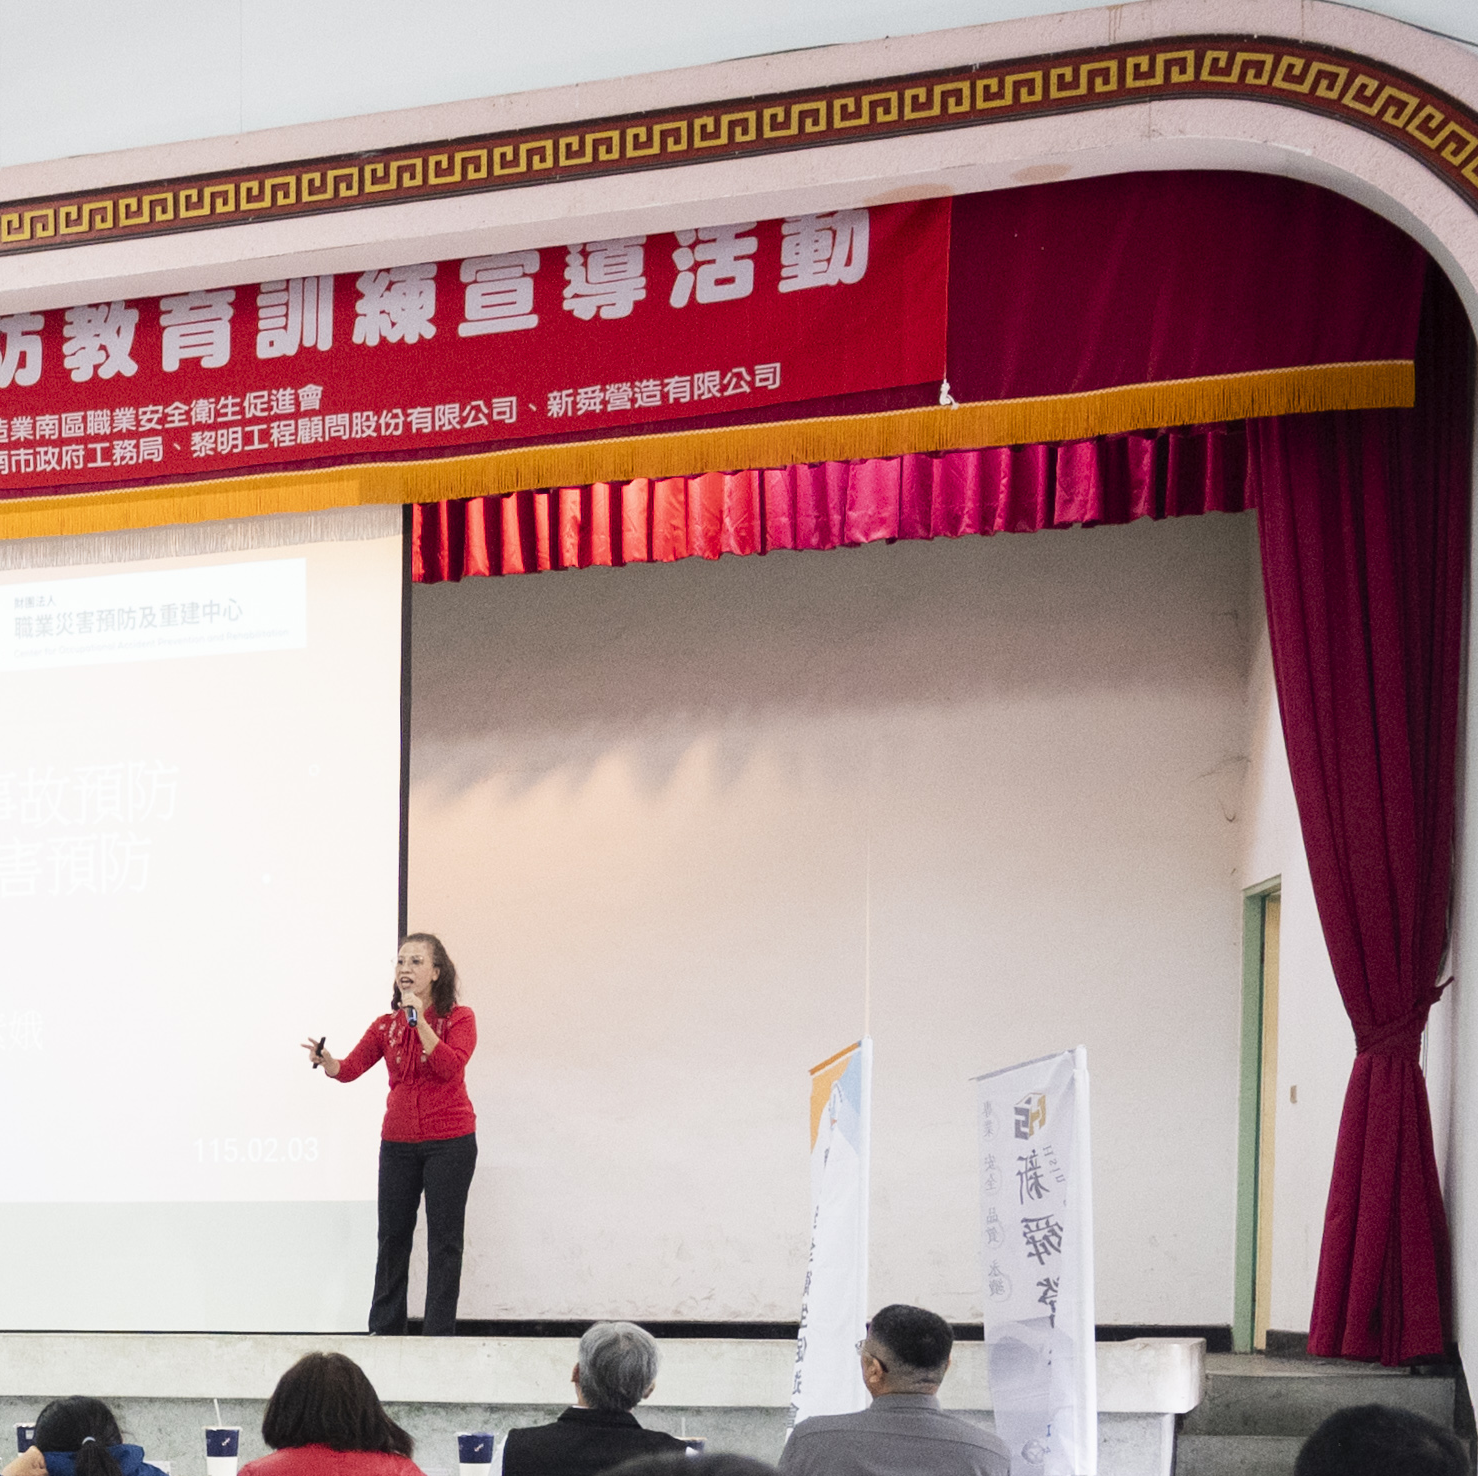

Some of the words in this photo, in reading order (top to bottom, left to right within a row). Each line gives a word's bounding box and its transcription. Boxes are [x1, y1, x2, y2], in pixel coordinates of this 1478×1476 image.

[13, 597, 244, 639] 職業災害預防及重建中心
[14, 648, 42, 659] Center
[44, 646, 57, 657] for
[58, 641, 116, 656] Occupational
[117, 638, 156, 651] Accident
[157, 635, 204, 648] Prevention
[207, 632, 225, 643] and
[226, 628, 289, 642] Rehabilitation
[193, 1135, 320, 1164] 115.02.03
